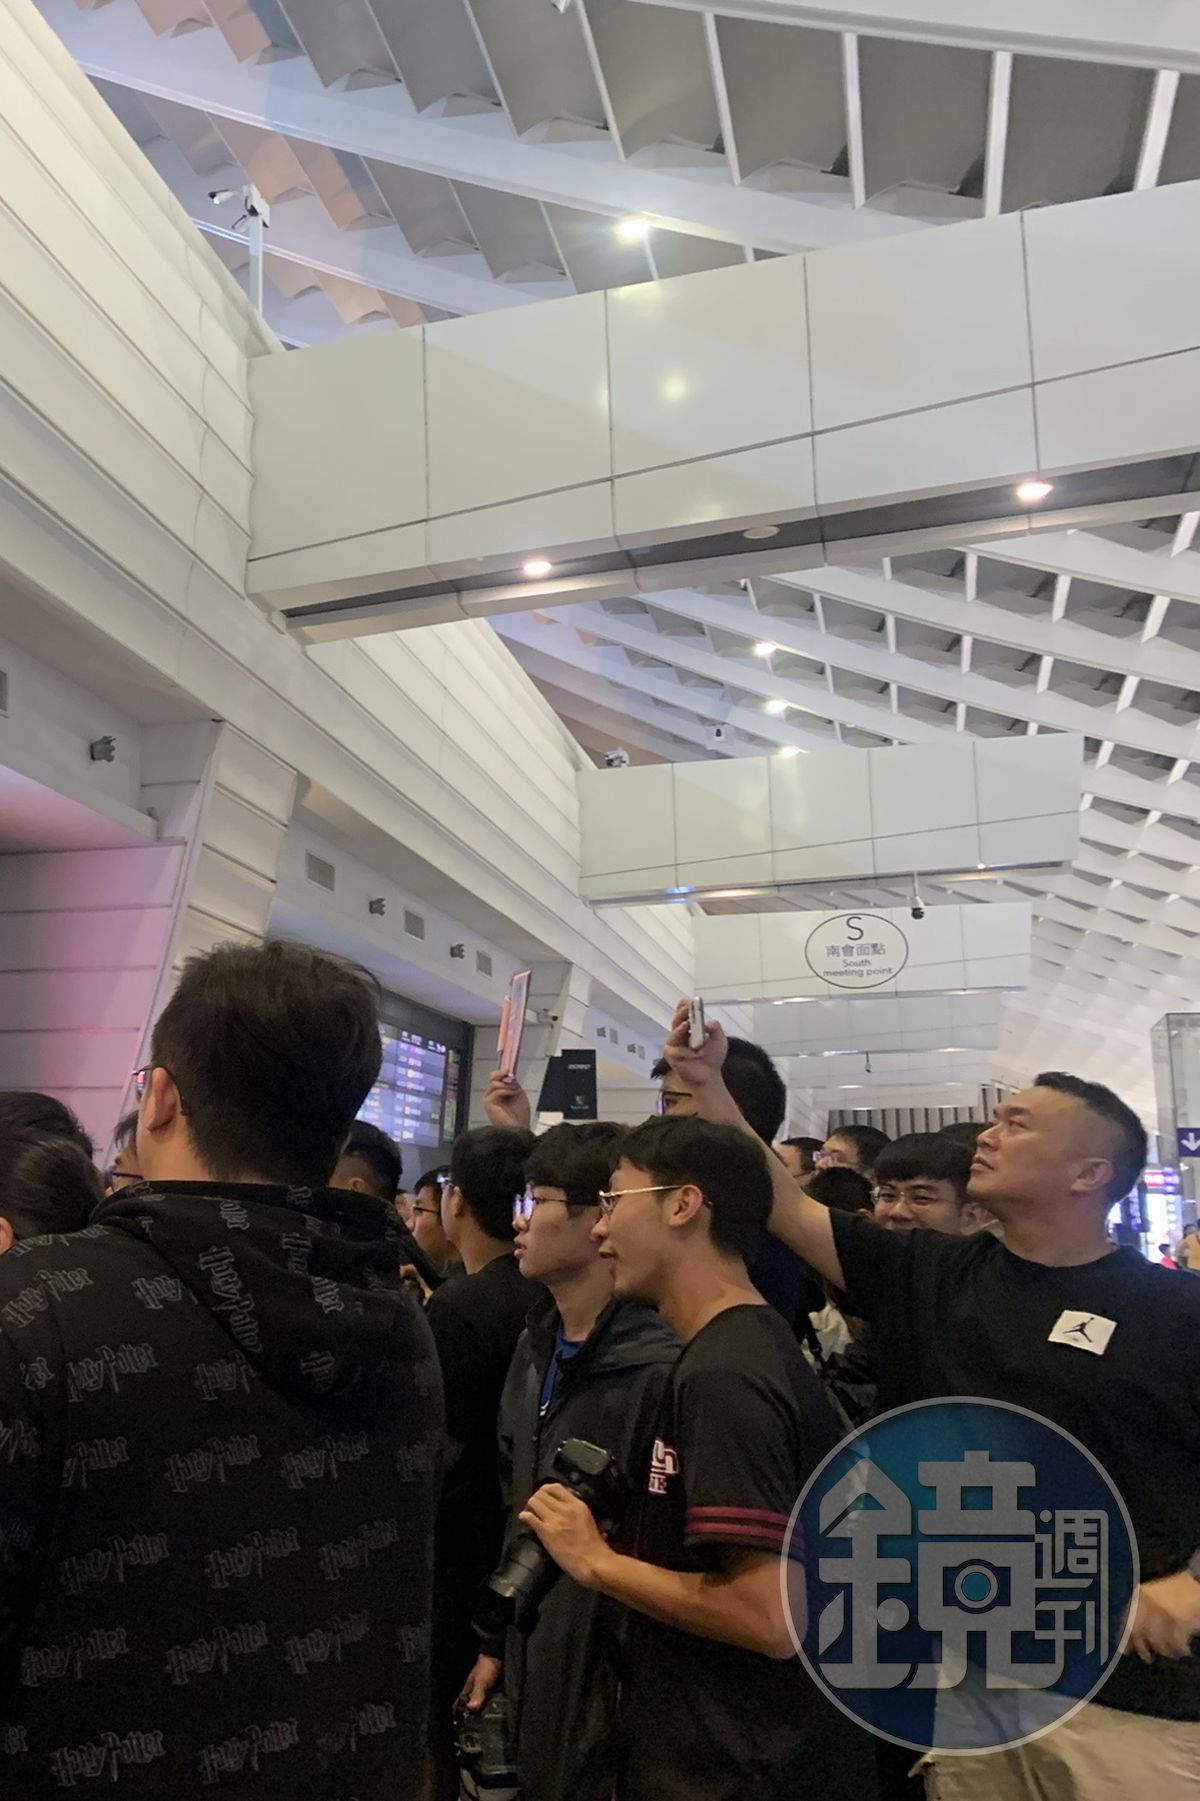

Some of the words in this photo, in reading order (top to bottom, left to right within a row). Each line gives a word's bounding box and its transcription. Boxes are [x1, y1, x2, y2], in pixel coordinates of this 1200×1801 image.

[846, 916, 864, 941] S
[825, 943, 886, 957] 南會面點
[842, 959, 871, 967] South
[823, 969, 864, 977] meeting
[866, 967, 893, 976] point
